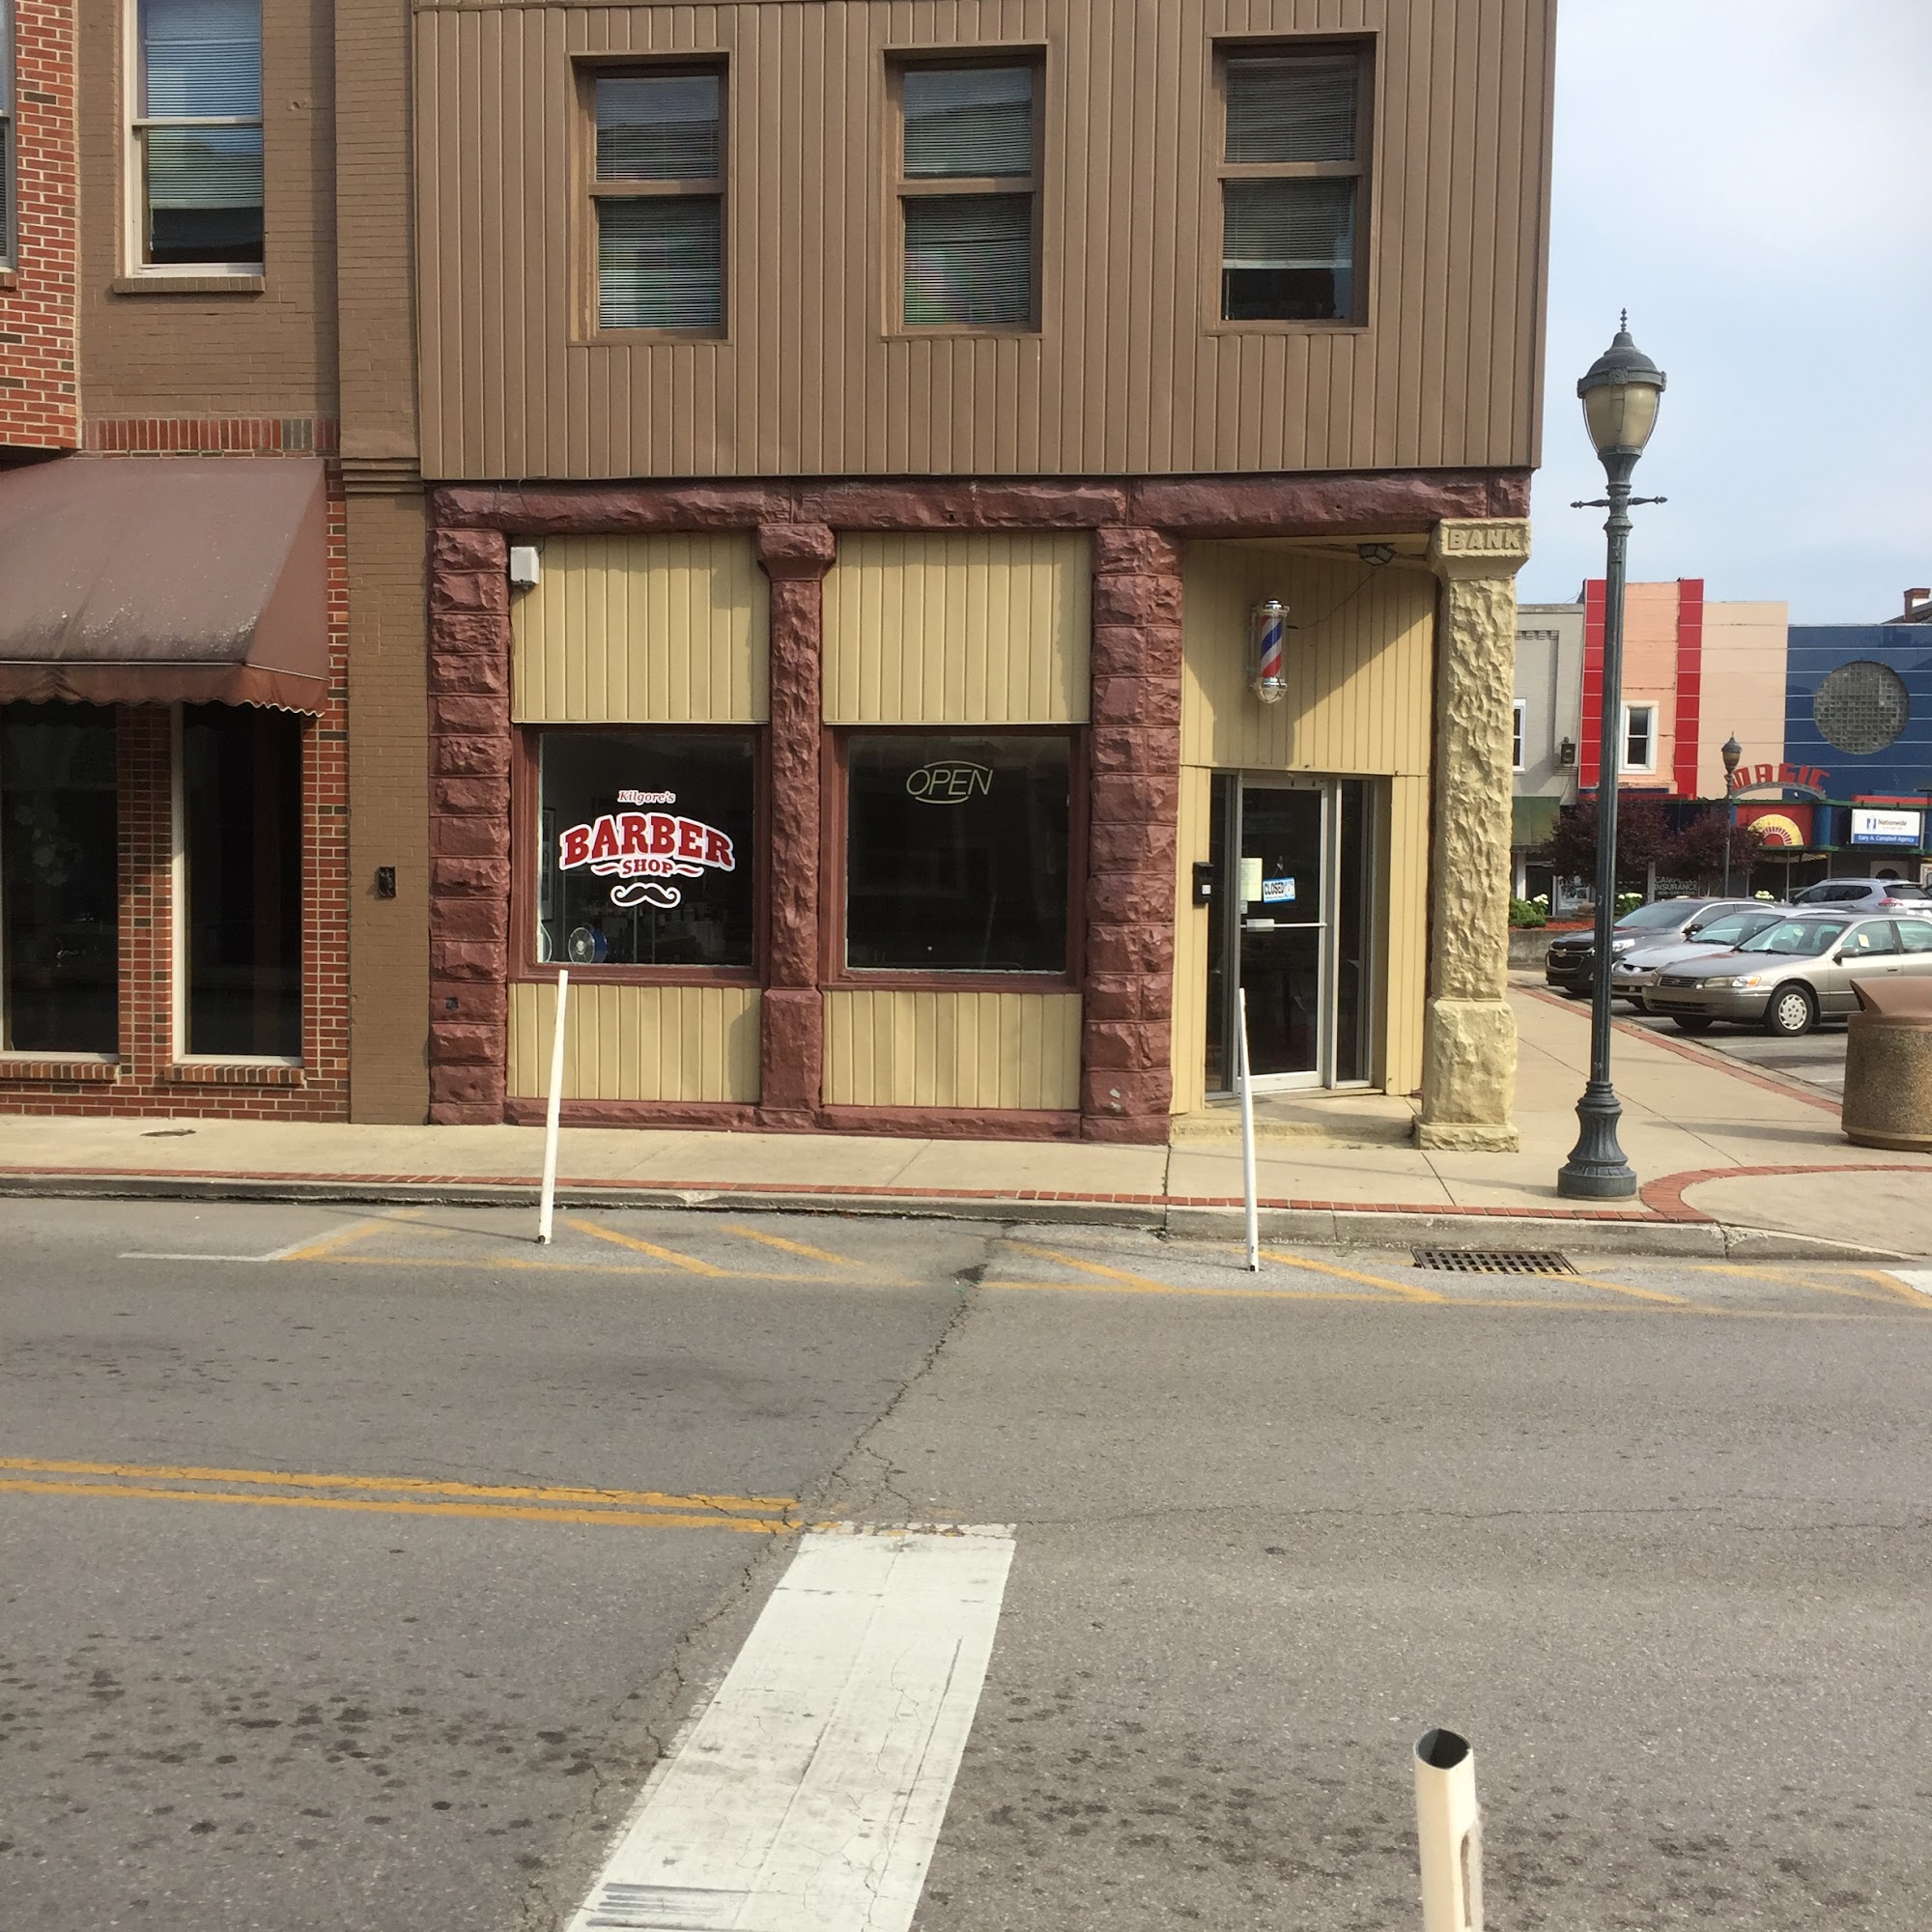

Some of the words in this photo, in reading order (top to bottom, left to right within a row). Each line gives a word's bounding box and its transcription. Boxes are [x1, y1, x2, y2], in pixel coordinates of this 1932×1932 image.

[1448, 527, 1521, 550] BANK
[906, 769, 993, 795] OPEN
[1731, 762, 1831, 791] MAGIC
[617, 790, 676, 805] Kilgore's
[561, 813, 735, 870] BARBER
[622, 858, 674, 874] SHOP
[1264, 881, 1284, 895] CLOSED
